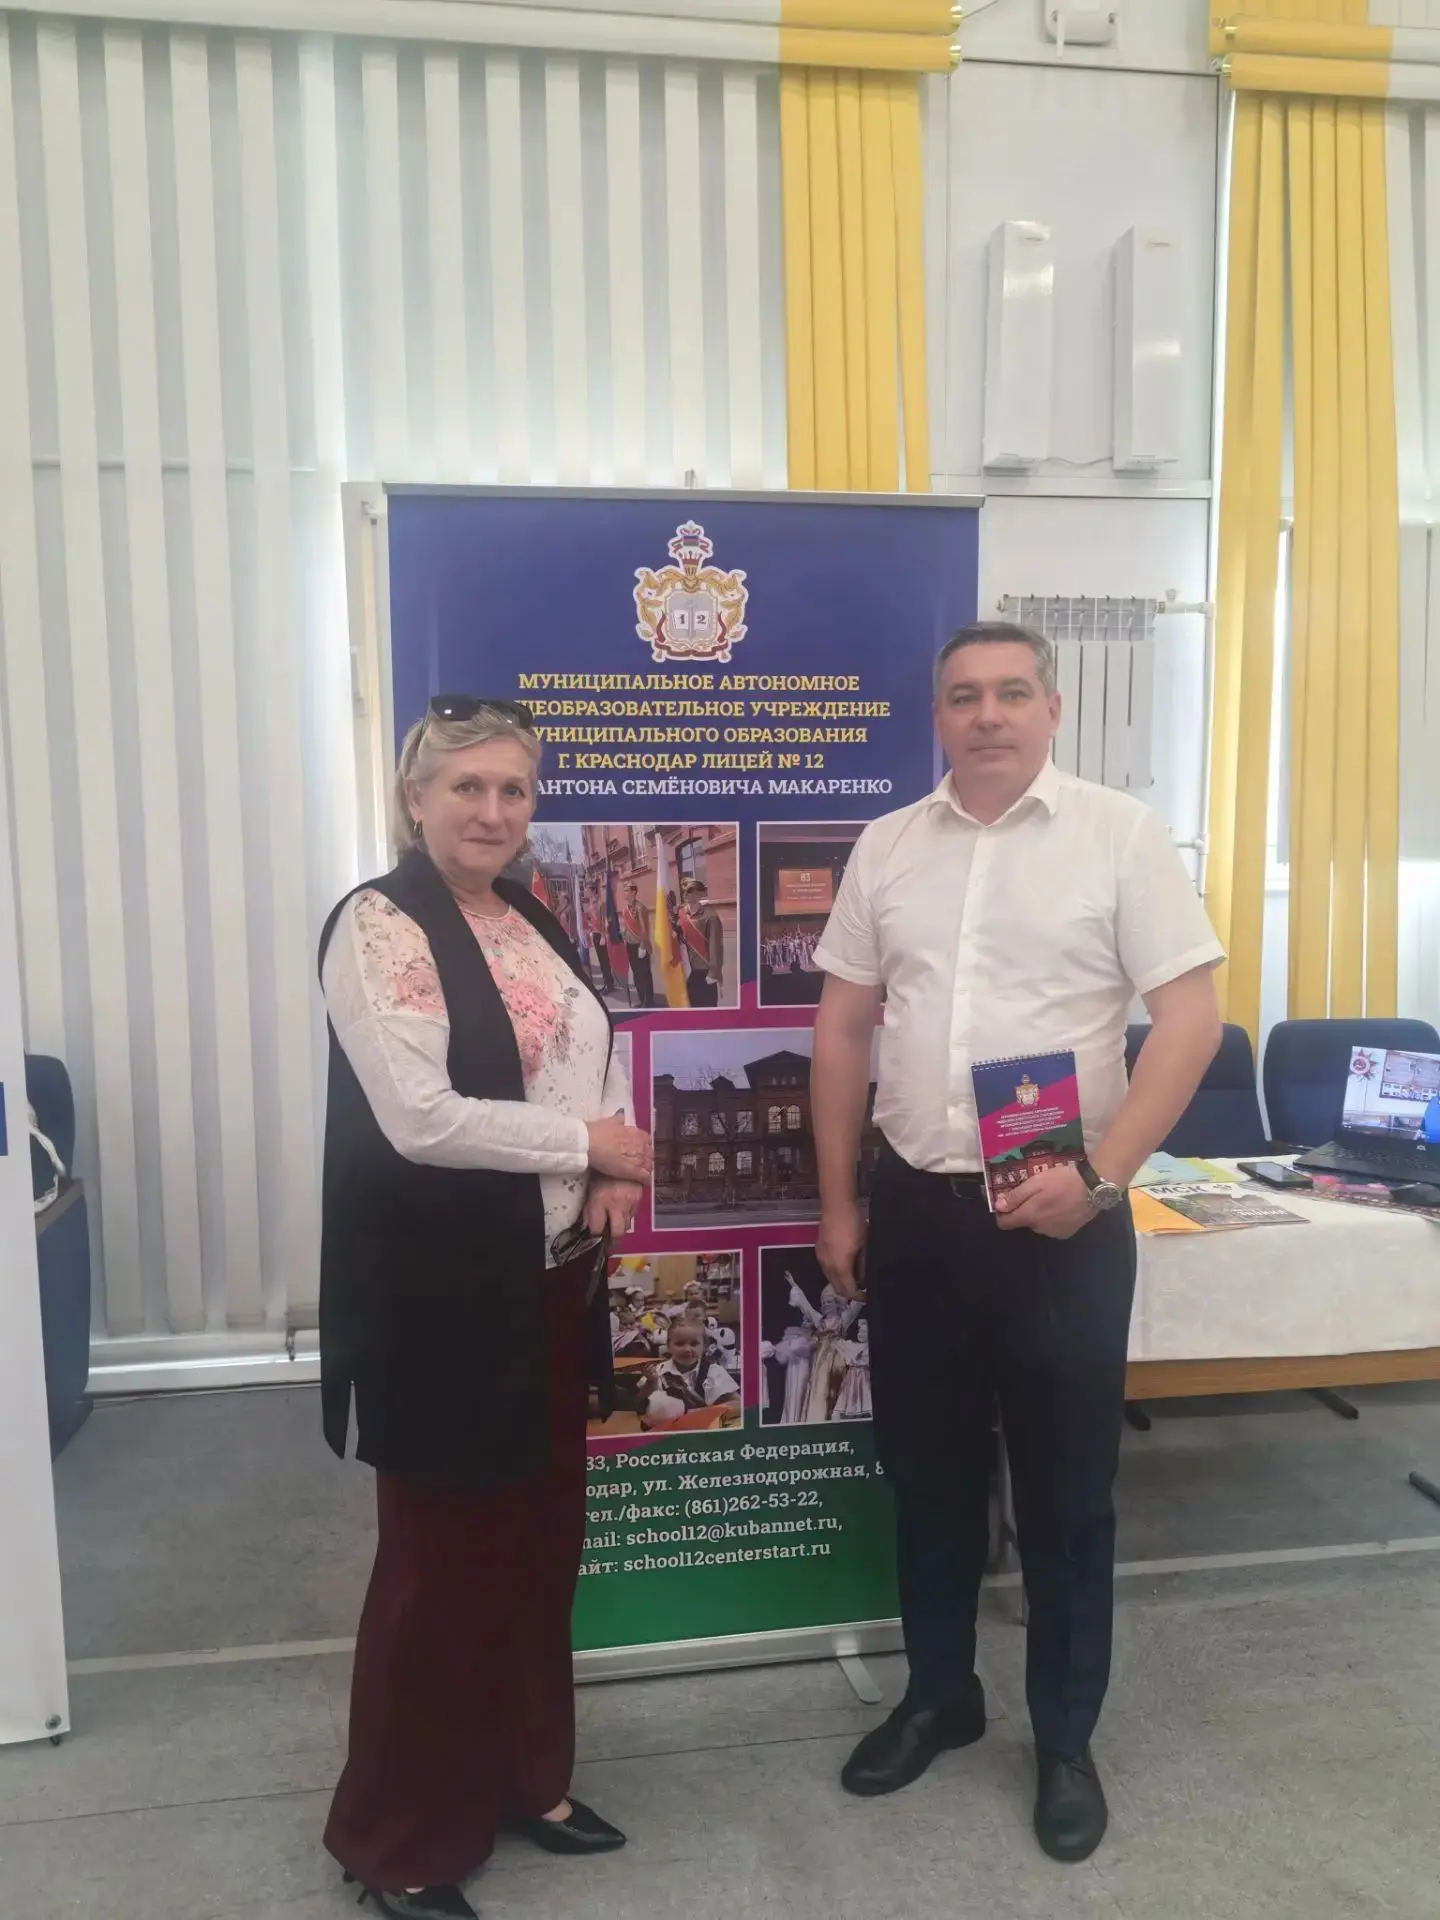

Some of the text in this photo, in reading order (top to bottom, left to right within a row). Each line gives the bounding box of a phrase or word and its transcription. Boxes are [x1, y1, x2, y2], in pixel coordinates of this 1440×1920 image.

[518, 673, 860, 692] МУНИЦИПАЛЬНОЕ АВТОНОМНОЕ
[750, 701, 891, 719] УЧРЕЖДЕНИЕ
[531, 726, 868, 745] УНИЦИПАЛЬНОГО ОБРАЗОВАНИЯ
[558, 750, 825, 772] Г. КРАСНОДАР ЛИЦЕЙ № 12
[622, 776, 764, 795] СЕМЁНОВИЧА
[768, 779, 893, 795] МАКАРЕНКО
[615, 1448, 735, 1469] Российская
[740, 1441, 855, 1461] Федерация,
[642, 1479, 673, 1496] ул.
[678, 1464, 870, 1490] Железнодорожная,
[684, 1490, 823, 1519] (861)262-53-22,
[626, 1517, 843, 1546] school12@kubannet.ru,
[623, 1543, 831, 1572] school12centerstart.ru
